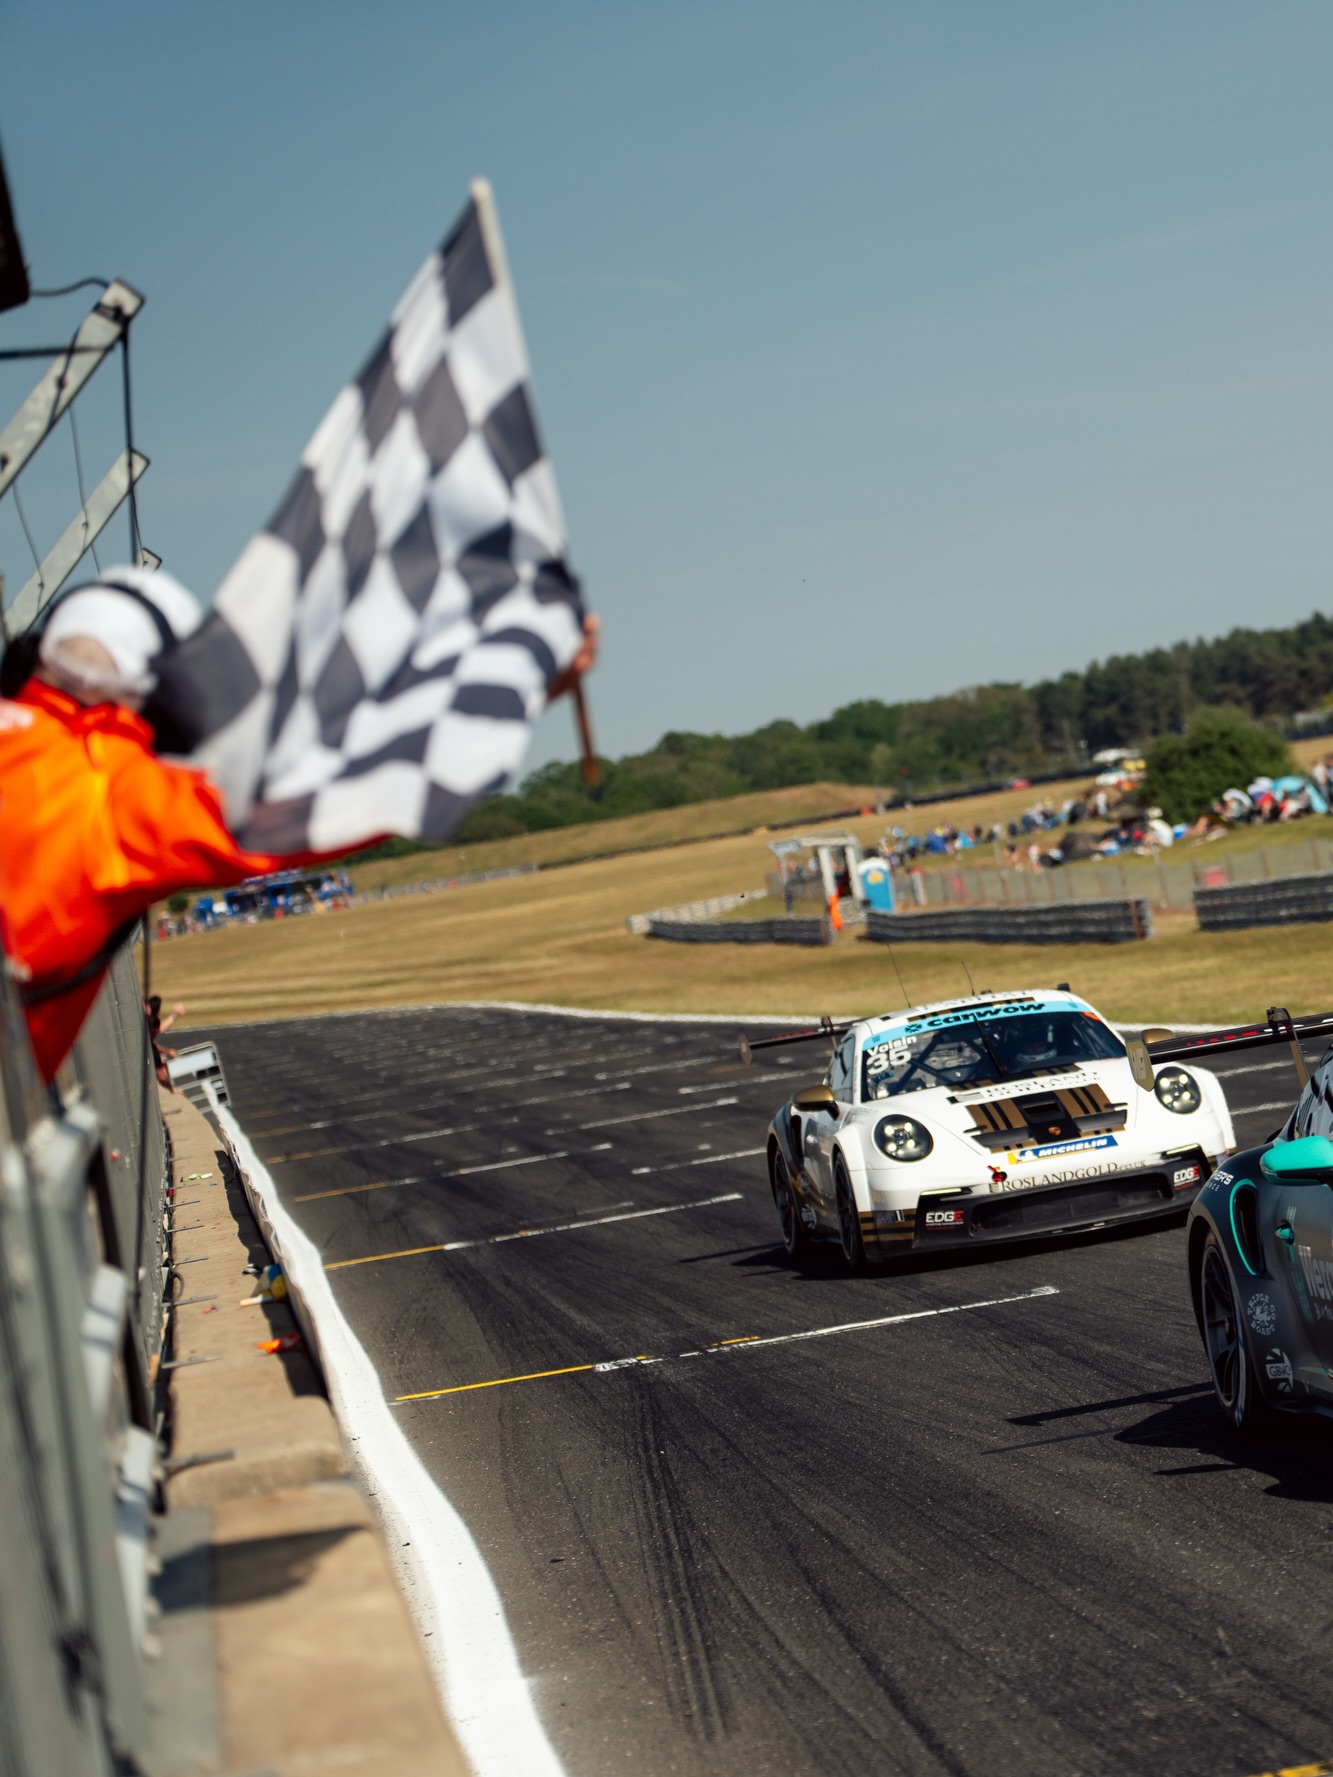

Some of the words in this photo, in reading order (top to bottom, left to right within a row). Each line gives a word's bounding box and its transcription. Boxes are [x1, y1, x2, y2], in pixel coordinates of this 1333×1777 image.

[927, 1002, 1046, 1028] carwow
[866, 1036, 918, 1057] Voisin
[866, 1045, 912, 1075] 35
[1037, 1138, 1108, 1157] MICHELIN
[1173, 1165, 1199, 1183] EDGE
[925, 1209, 965, 1223] EDGE
